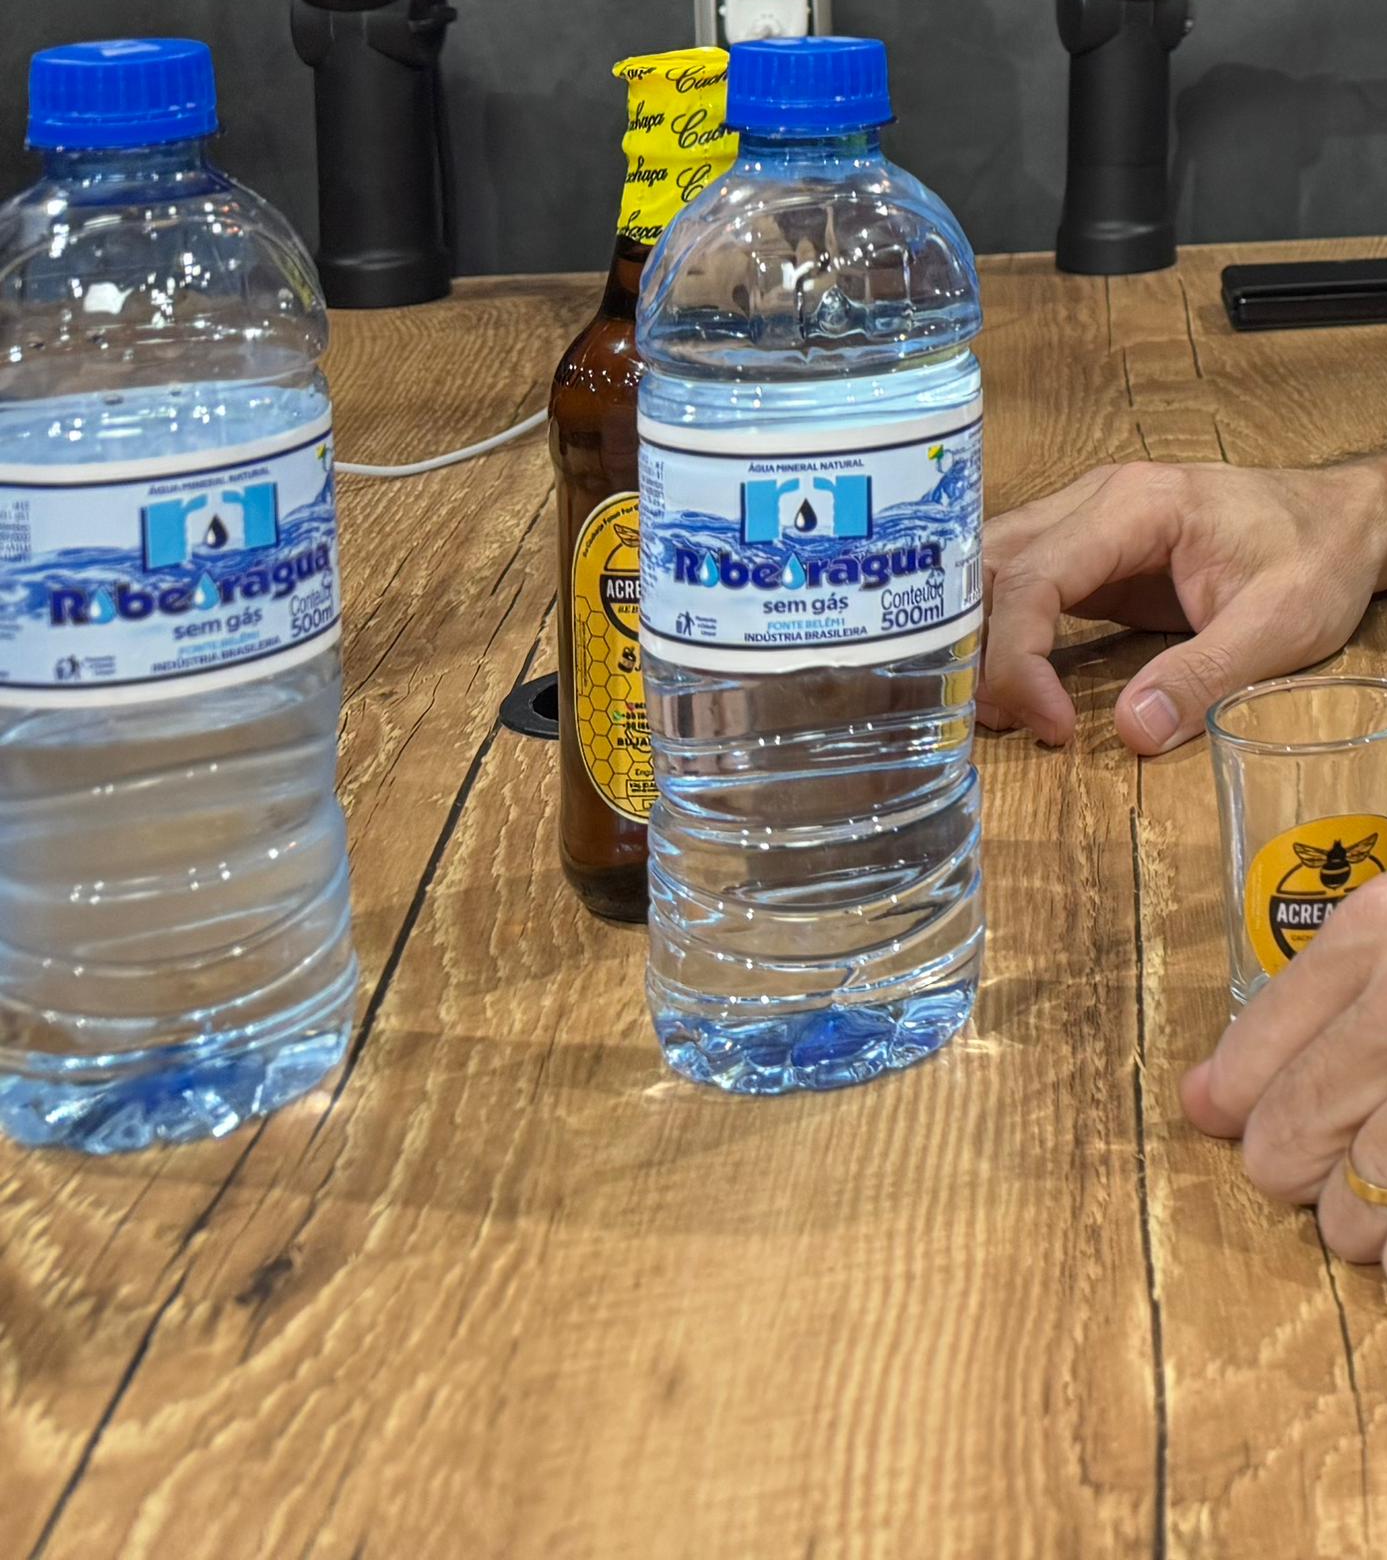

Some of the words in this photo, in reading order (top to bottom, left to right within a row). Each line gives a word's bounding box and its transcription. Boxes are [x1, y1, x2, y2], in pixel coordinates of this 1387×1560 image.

[776, 462, 818, 473] MINERAL
[820, 458, 864, 471] NATURAL
[606, 579, 641, 599] ACRE
[763, 598, 807, 615] sem
[881, 596, 944, 631] 500ml
[173, 618, 222, 640] sem
[804, 626, 868, 641] BRASILEIRA
[1276, 902, 1334, 925] ACREA
